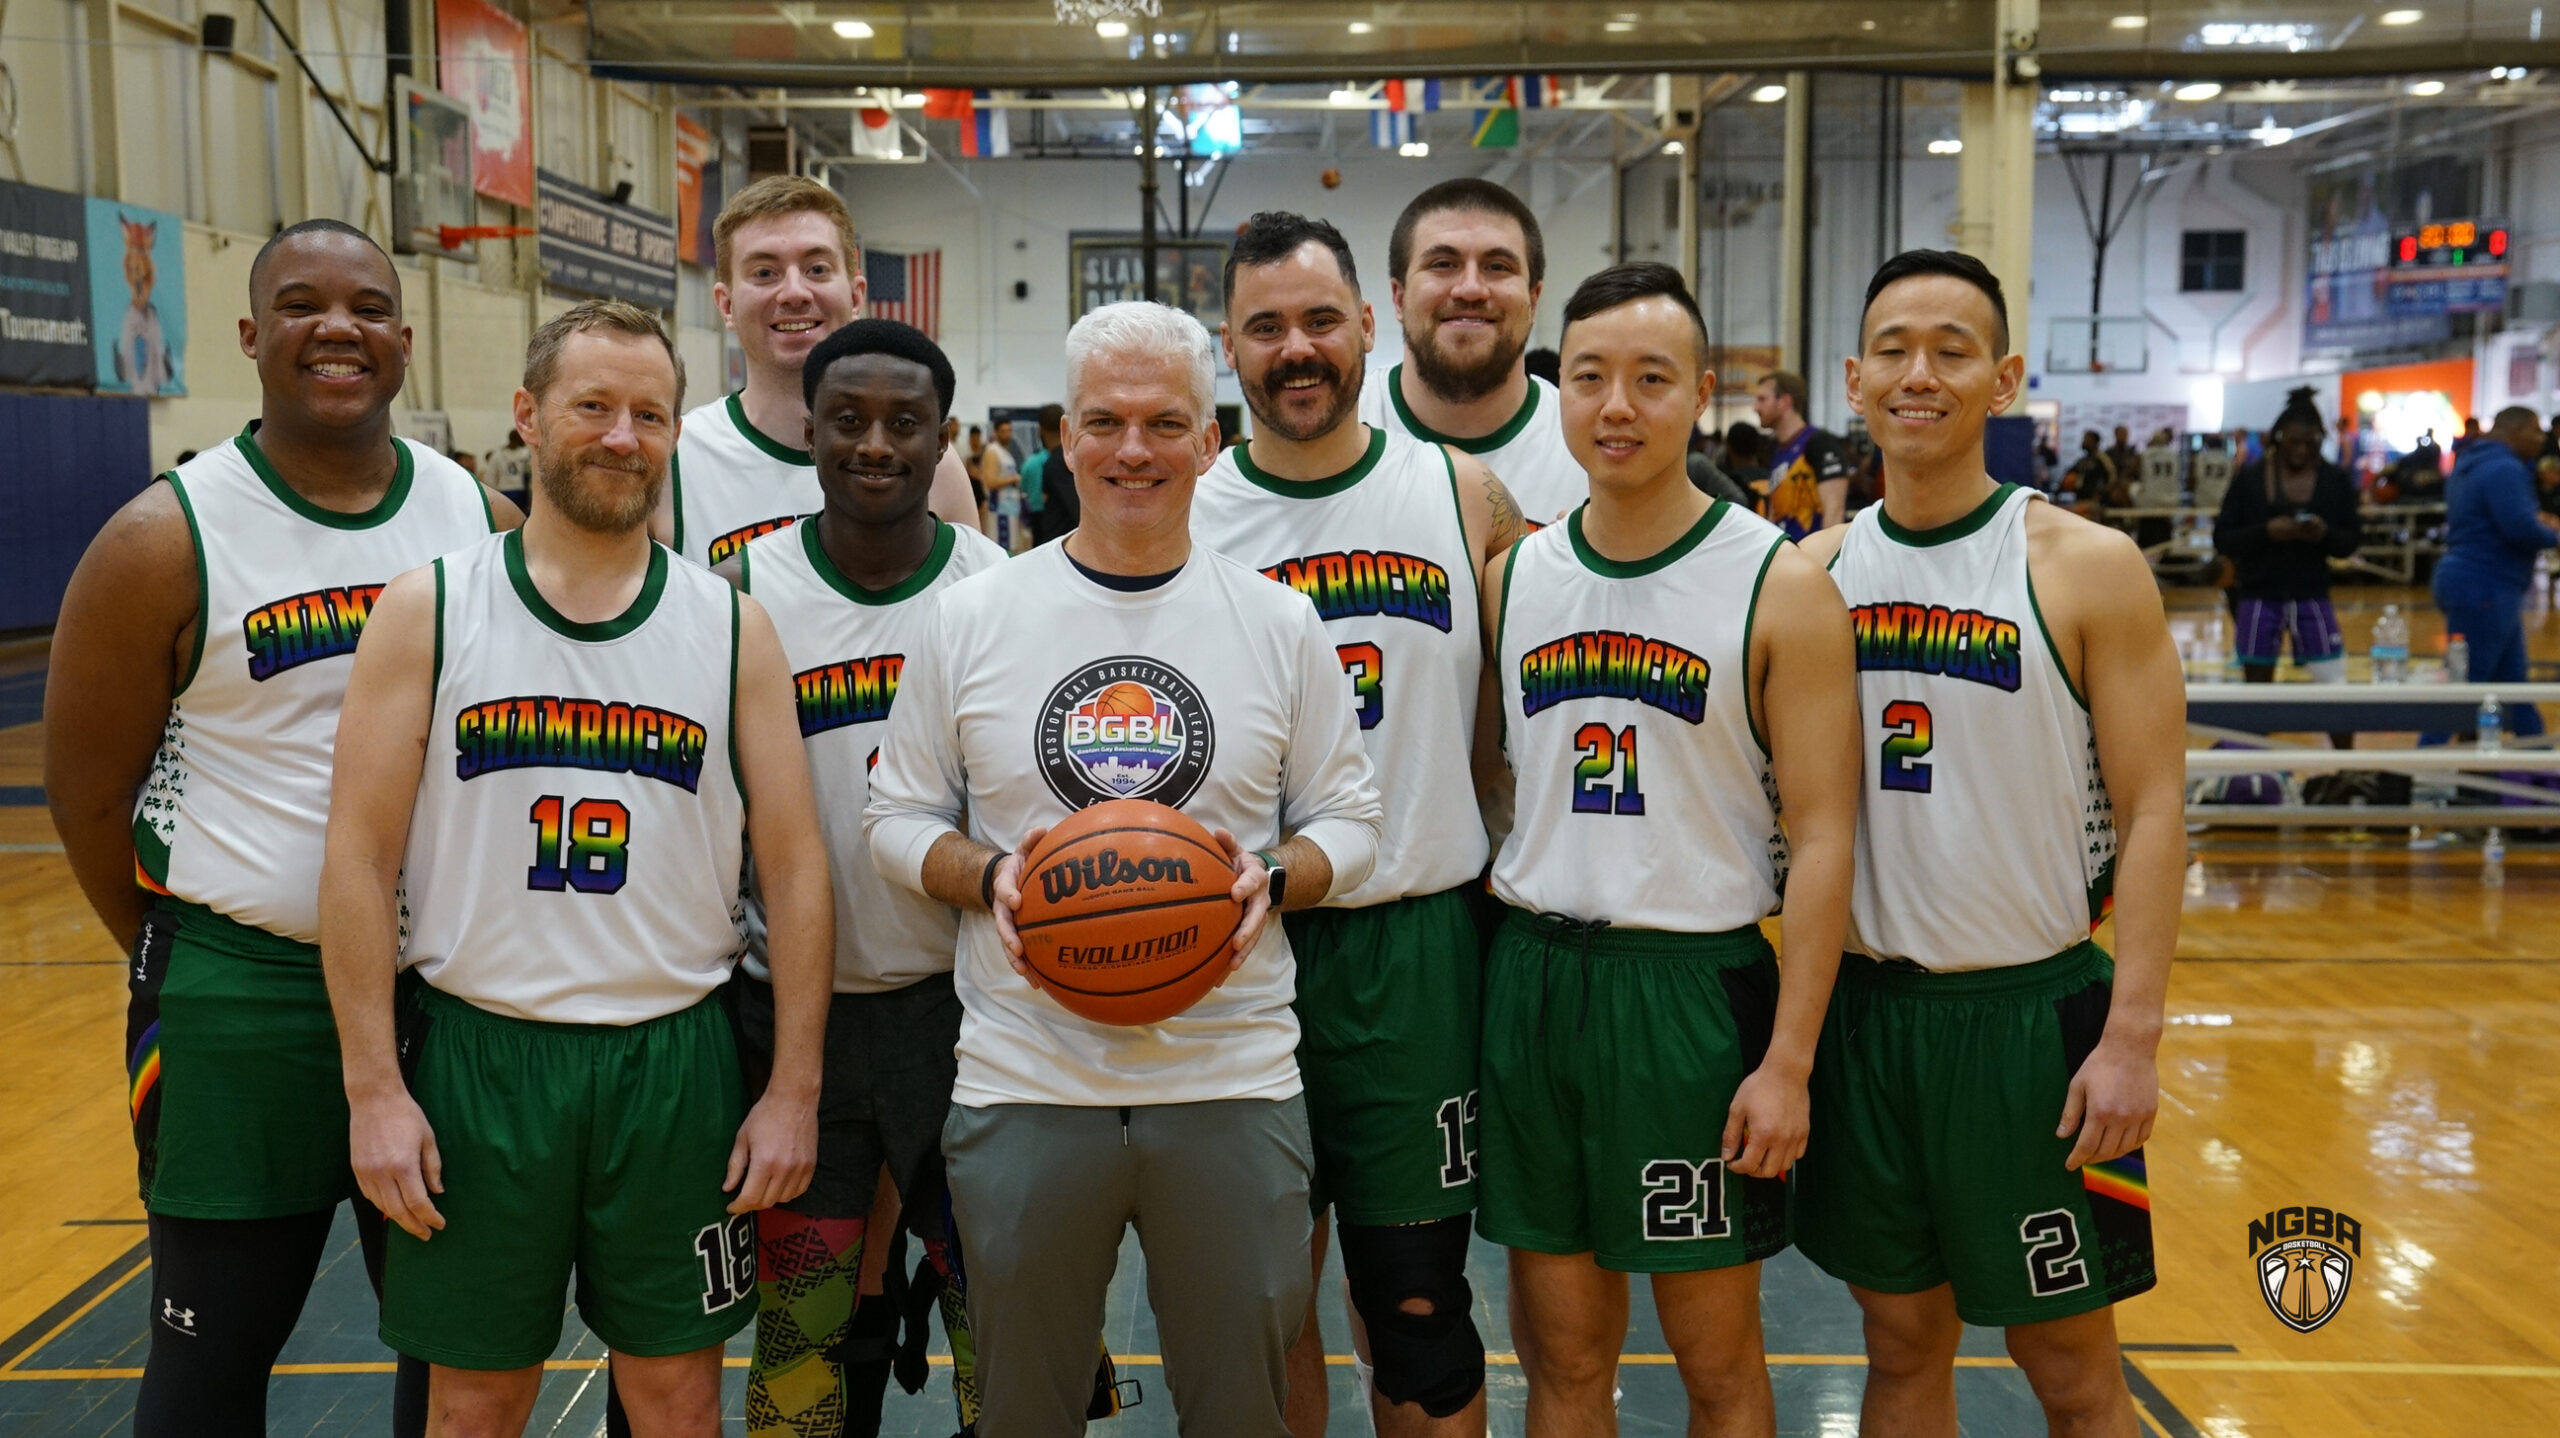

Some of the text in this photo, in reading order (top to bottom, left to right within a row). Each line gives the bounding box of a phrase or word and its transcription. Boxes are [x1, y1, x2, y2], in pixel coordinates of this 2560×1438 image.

[610, 220, 638, 258] EDGE
[243, 583, 387, 682] SHAM
[1257, 549, 1452, 634] MROCKS
[1335, 640, 1384, 730] 3
[1849, 601, 2022, 693] AMROCKS
[793, 653, 906, 739] HAMR
[1046, 666, 1204, 768] BOSTON GAY BASKETBALL LEAGUE
[1070, 714, 1181, 746] BGBL
[456, 695, 707, 796] SHAMROCKS
[1571, 722, 1645, 816] 21
[1880, 699, 1933, 793] 2
[527, 794, 631, 895] 18
[1039, 848, 1193, 904] Wilson
[1058, 925, 1198, 964] EVOLUTION
[1641, 1157, 1731, 1241] 21
[694, 1214, 757, 1315] 18
[2019, 1207, 2090, 1298] 2
